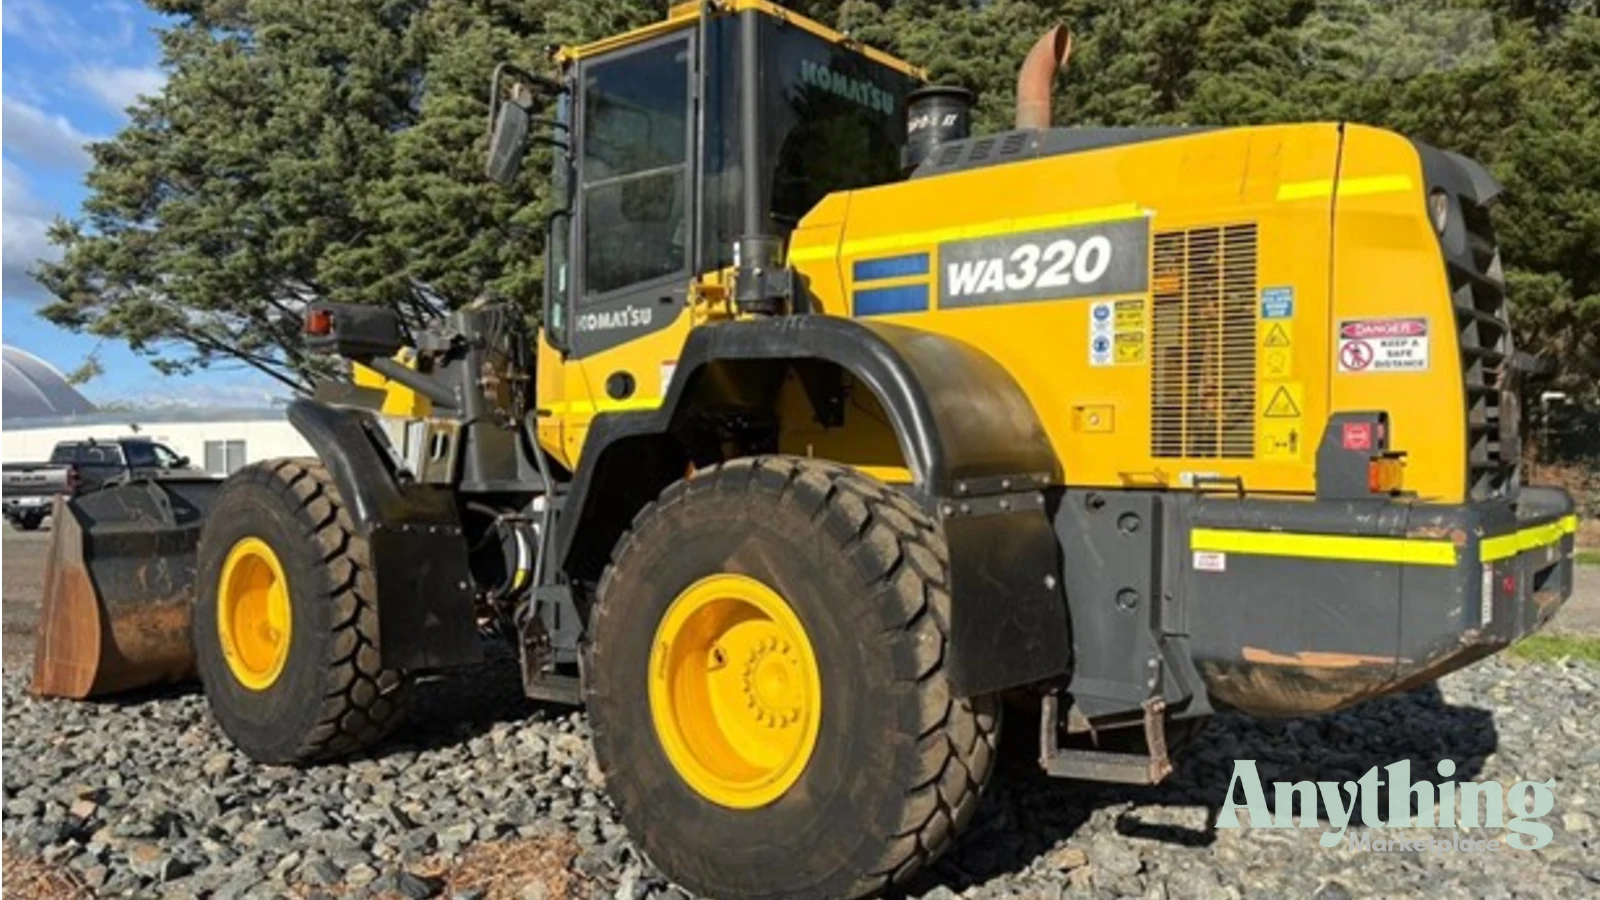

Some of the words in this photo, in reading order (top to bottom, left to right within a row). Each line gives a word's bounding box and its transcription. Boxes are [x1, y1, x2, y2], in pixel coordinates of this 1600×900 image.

[801, 60, 894, 115] KOMATSU
[947, 235, 1111, 296] WA320
[576, 305, 652, 331] KOMATSU
[1355, 323, 1411, 337] DANGER
[1380, 339, 1408, 348] KEEP
[1411, 339, 1419, 347] A
[1387, 349, 1413, 358] SAFE
[1374, 359, 1424, 369] DISTANCE
